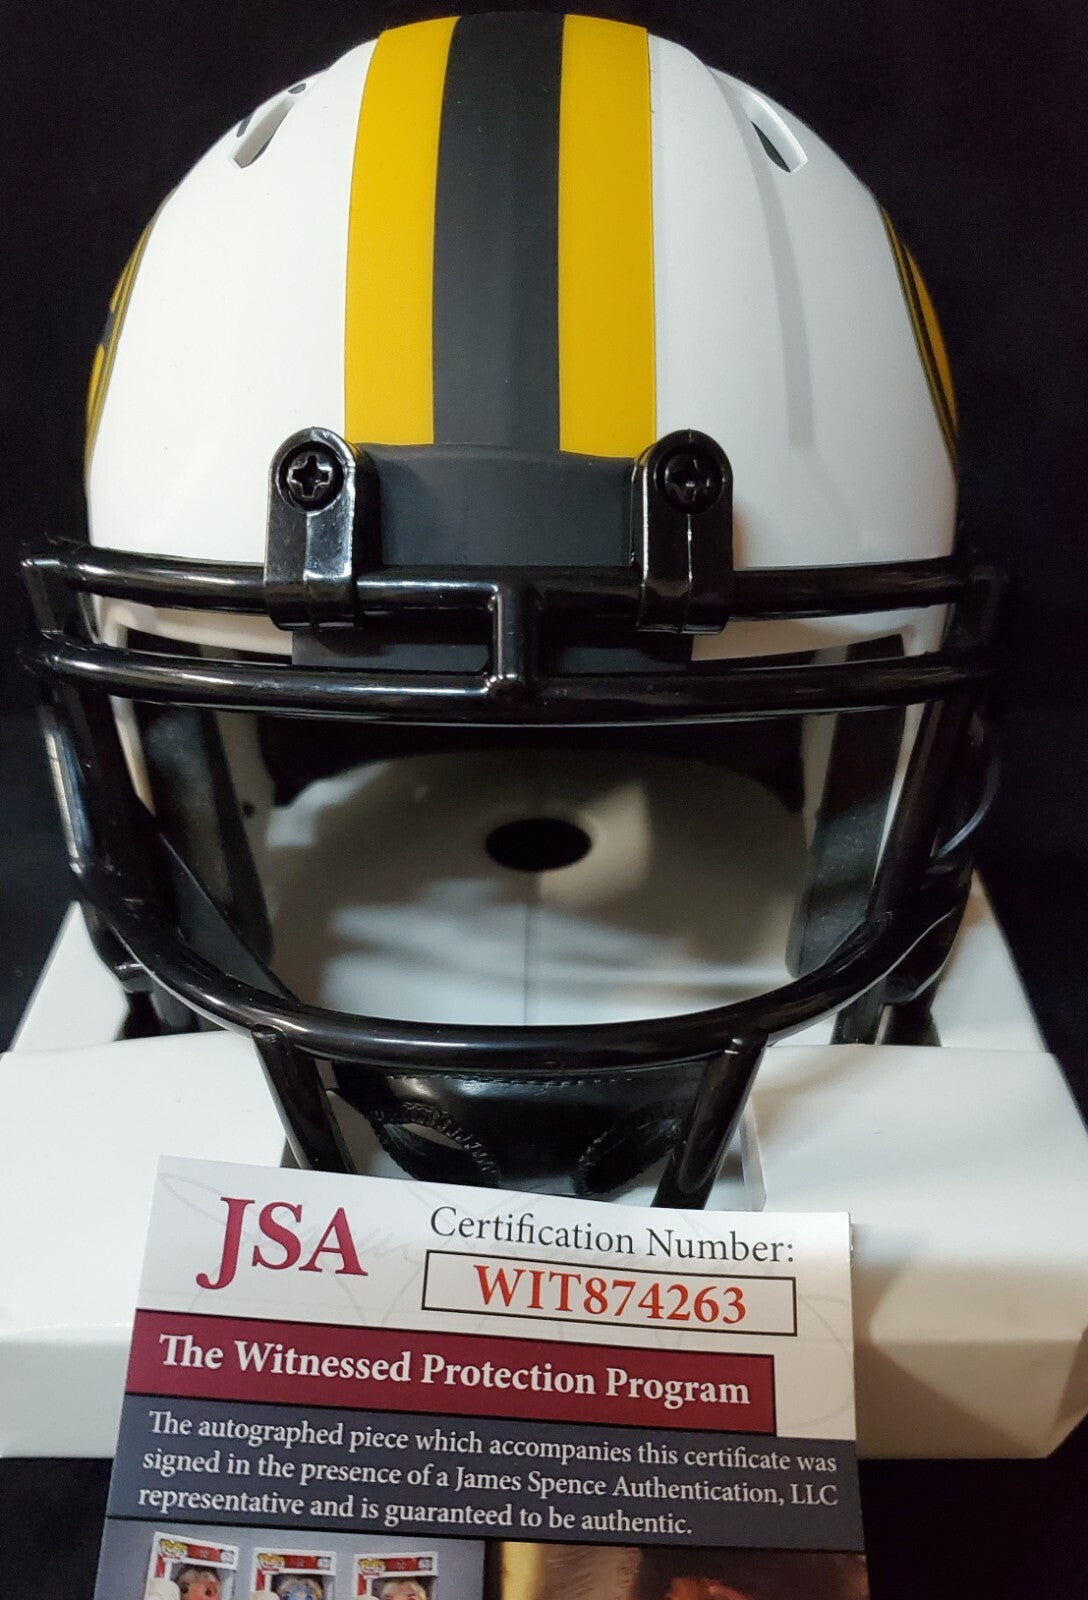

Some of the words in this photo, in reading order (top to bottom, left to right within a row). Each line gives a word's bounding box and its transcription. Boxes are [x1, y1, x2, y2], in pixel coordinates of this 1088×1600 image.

[197, 1198, 368, 1289] JSA
[431, 1207, 634, 1254] Certification
[647, 1229, 793, 1261] Number:
[475, 1265, 746, 1324] WIT874263
[159, 1334, 223, 1369] The
[234, 1341, 411, 1381] Witnessed
[421, 1354, 596, 1394] Protection
[606, 1368, 750, 1409] Program
[149, 1411, 192, 1435] The
[198, 1419, 343, 1449] autographed
[349, 1426, 409, 1453] piece
[415, 1429, 482, 1453] which
[490, 1440, 631, 1465] accompanies
[638, 1442, 678, 1464] this
[684, 1446, 790, 1470] certificate
[797, 1457, 836, 1472] was
[143, 1448, 220, 1477] signed
[227, 1453, 250, 1475] in
[258, 1454, 295, 1478] the
[300, 1464, 401, 1485] presence
[407, 1463, 434, 1485] of
[436, 1472, 449, 1486] a
[455, 1467, 521, 1491] James
[528, 1471, 606, 1499] Spence
[612, 1476, 784, 1505] Authentication,
[790, 1484, 838, 1505] LLC
[138, 1489, 304, 1514] representative
[310, 1495, 353, 1517] and
[361, 1498, 379, 1518] is
[385, 1504, 512, 1527] guaranteed
[520, 1509, 542, 1527] to
[549, 1506, 575, 1528] be
[581, 1509, 692, 1535] authentic.
